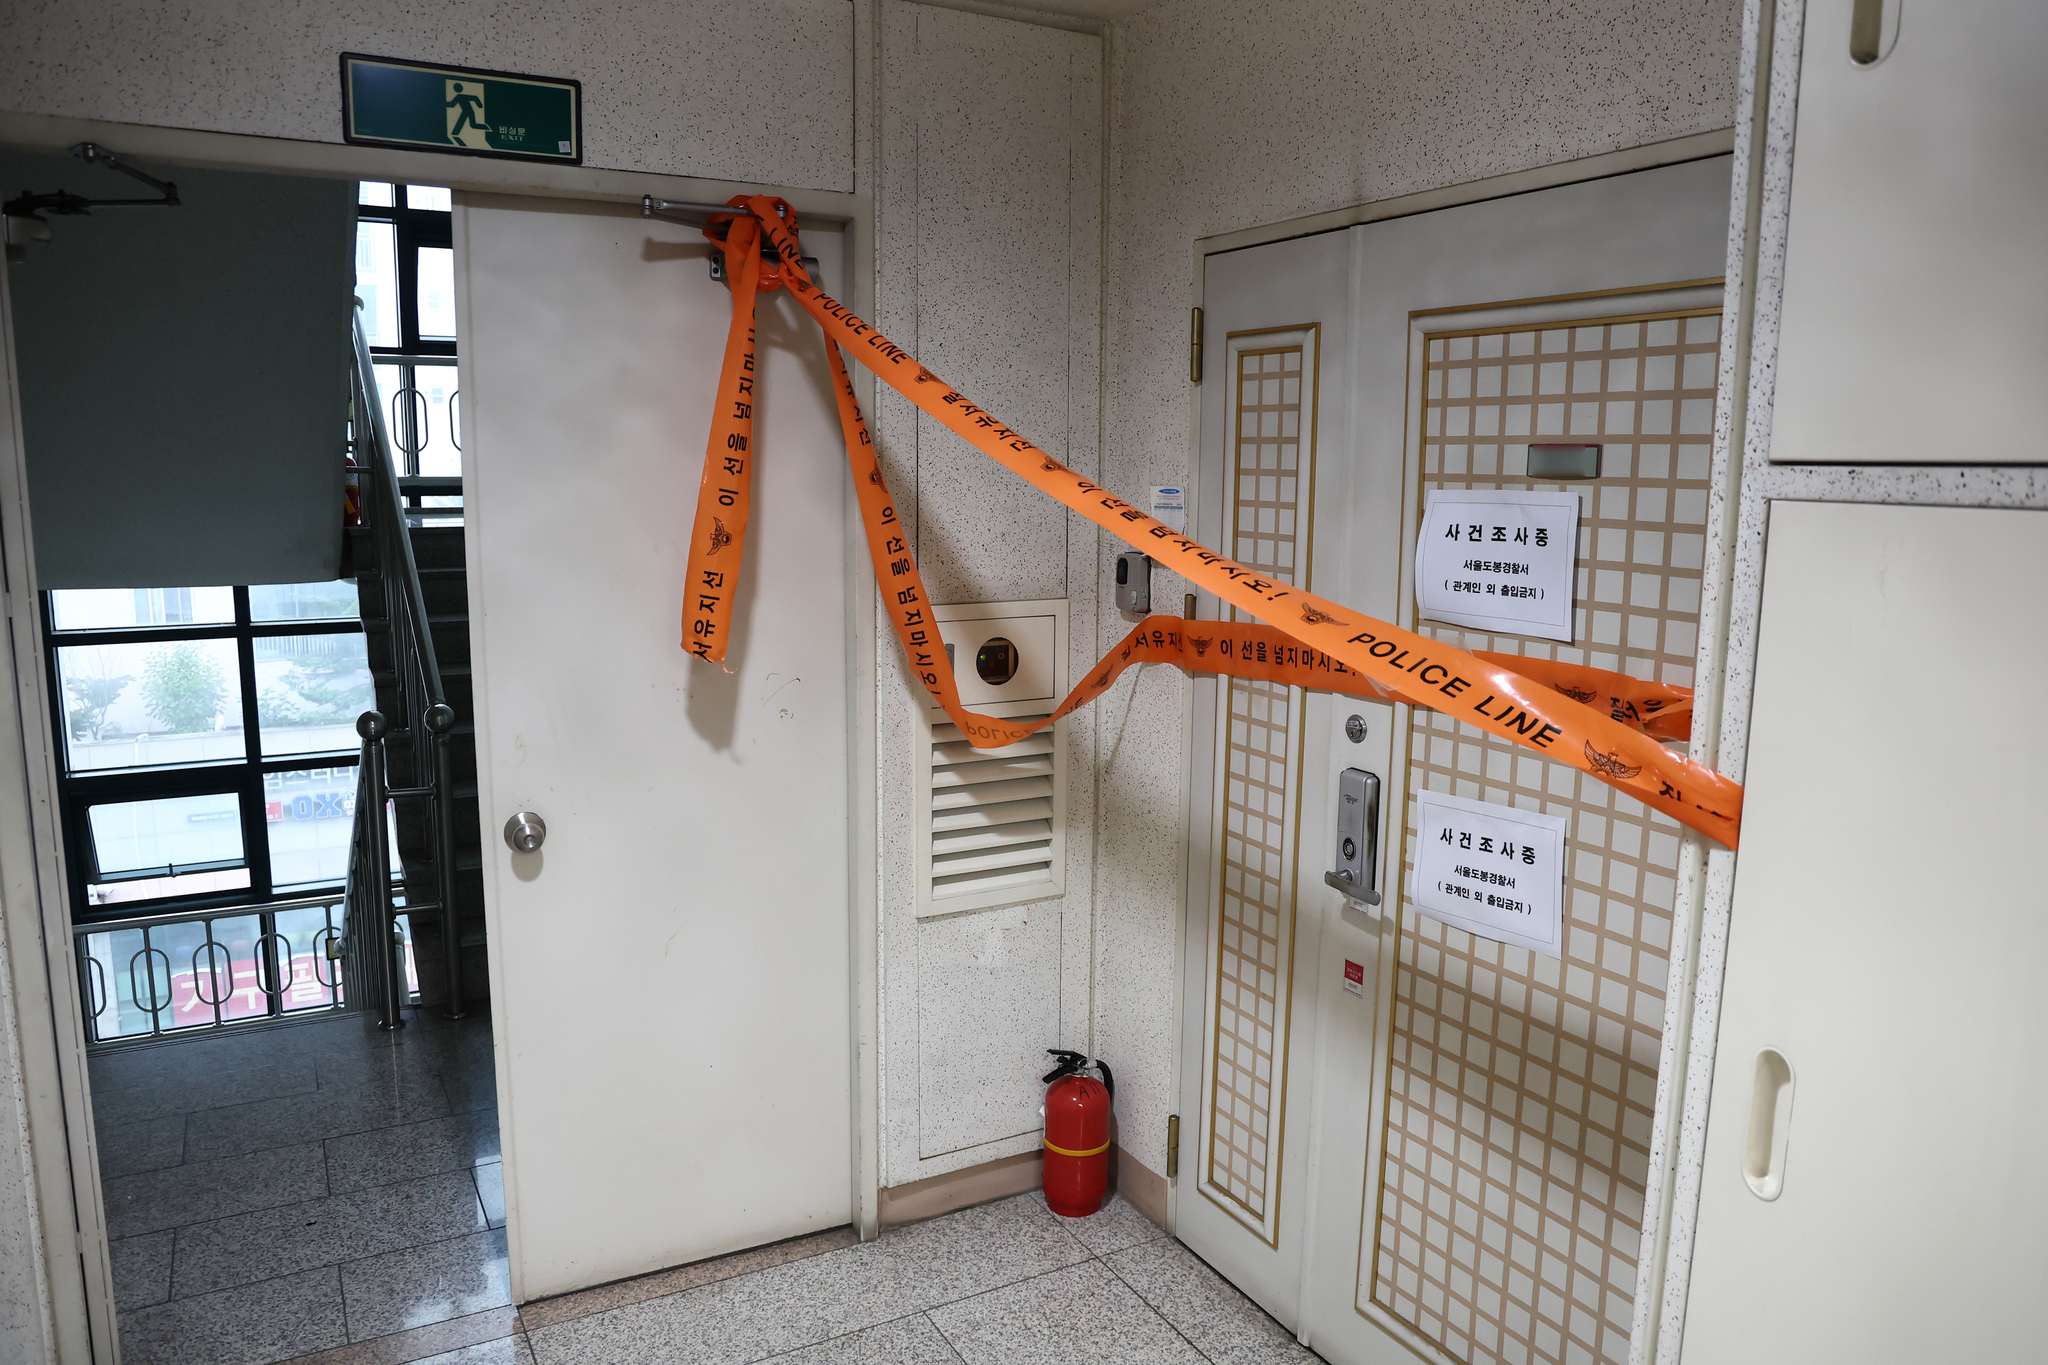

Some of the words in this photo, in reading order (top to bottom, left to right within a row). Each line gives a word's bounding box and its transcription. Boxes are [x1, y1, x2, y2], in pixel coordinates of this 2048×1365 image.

[499, 126, 526, 136] 비상문
[813, 291, 869, 336] POLICE
[868, 334, 908, 365] LINE
[723, 432, 748, 476] 선을
[718, 487, 740, 508] 이
[881, 506, 897, 526] 이
[886, 536, 911, 577] 선을
[1463, 559, 1530, 576] 서울도봉경찰서
[1452, 580, 1482, 594] 관계인
[1486, 583, 1496, 596] 외
[1500, 584, 1537, 600] 출입금지
[1220, 638, 1234, 659] 이
[1241, 640, 1267, 663] 선을
[1347, 631, 1473, 699] POLICE
[1473, 693, 1563, 749] LINE
[291, 793, 343, 820] OX
[1453, 864, 1516, 890] 서울도봉경찰서
[1445, 882, 1470, 899] 관계인
[1474, 890, 1483, 903] 외
[1487, 893, 1523, 914] 출입금지
